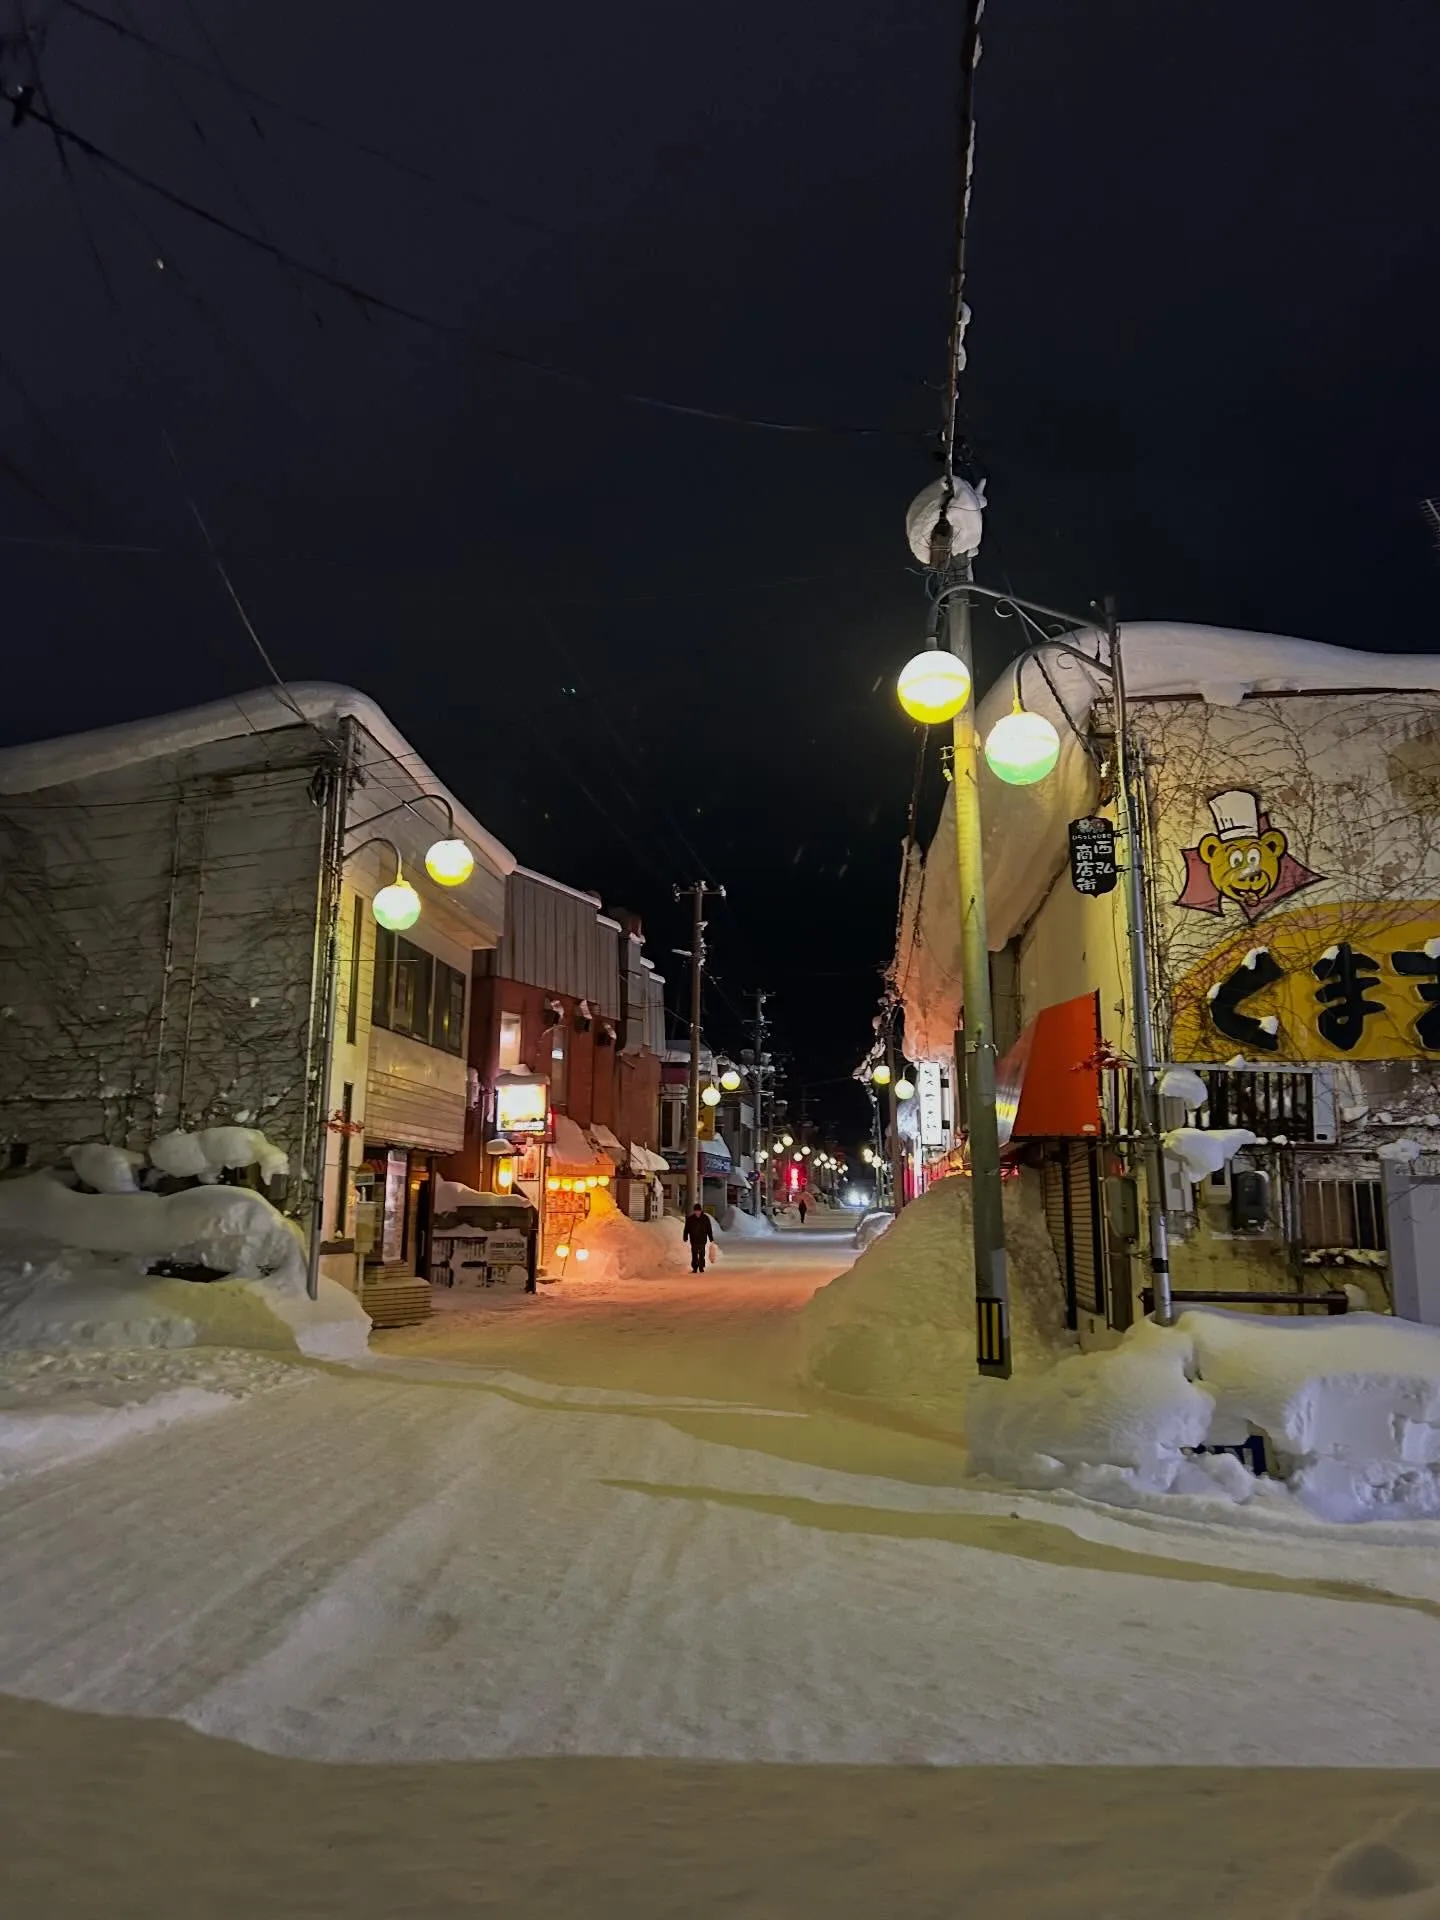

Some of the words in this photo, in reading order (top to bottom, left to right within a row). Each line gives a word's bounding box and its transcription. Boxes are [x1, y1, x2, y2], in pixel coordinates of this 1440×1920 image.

[1076, 843, 1097, 892] 商店街
[1093, 840, 1115, 875] 西弘
